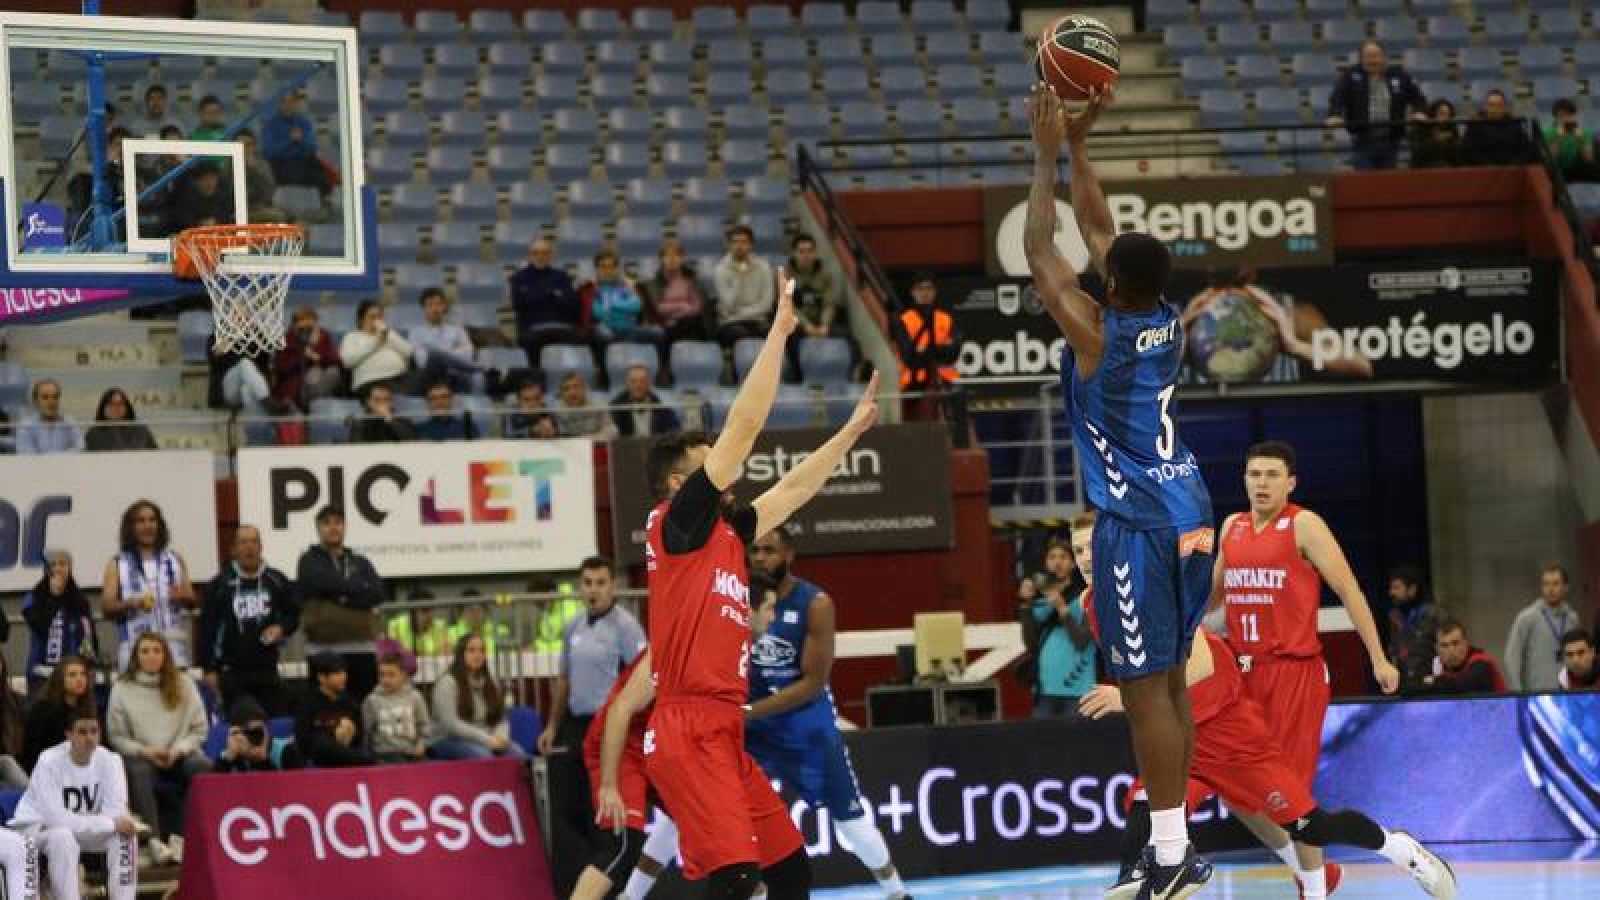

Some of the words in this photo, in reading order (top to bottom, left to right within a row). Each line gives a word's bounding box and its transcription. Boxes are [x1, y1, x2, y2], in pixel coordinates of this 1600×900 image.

[1107, 193, 1317, 250] Bengoa
[1311, 310, 1535, 371] protégelo
[1155, 383, 1176, 462] 3
[1240, 613, 1260, 642] 11
[218, 782, 526, 866] endesa
